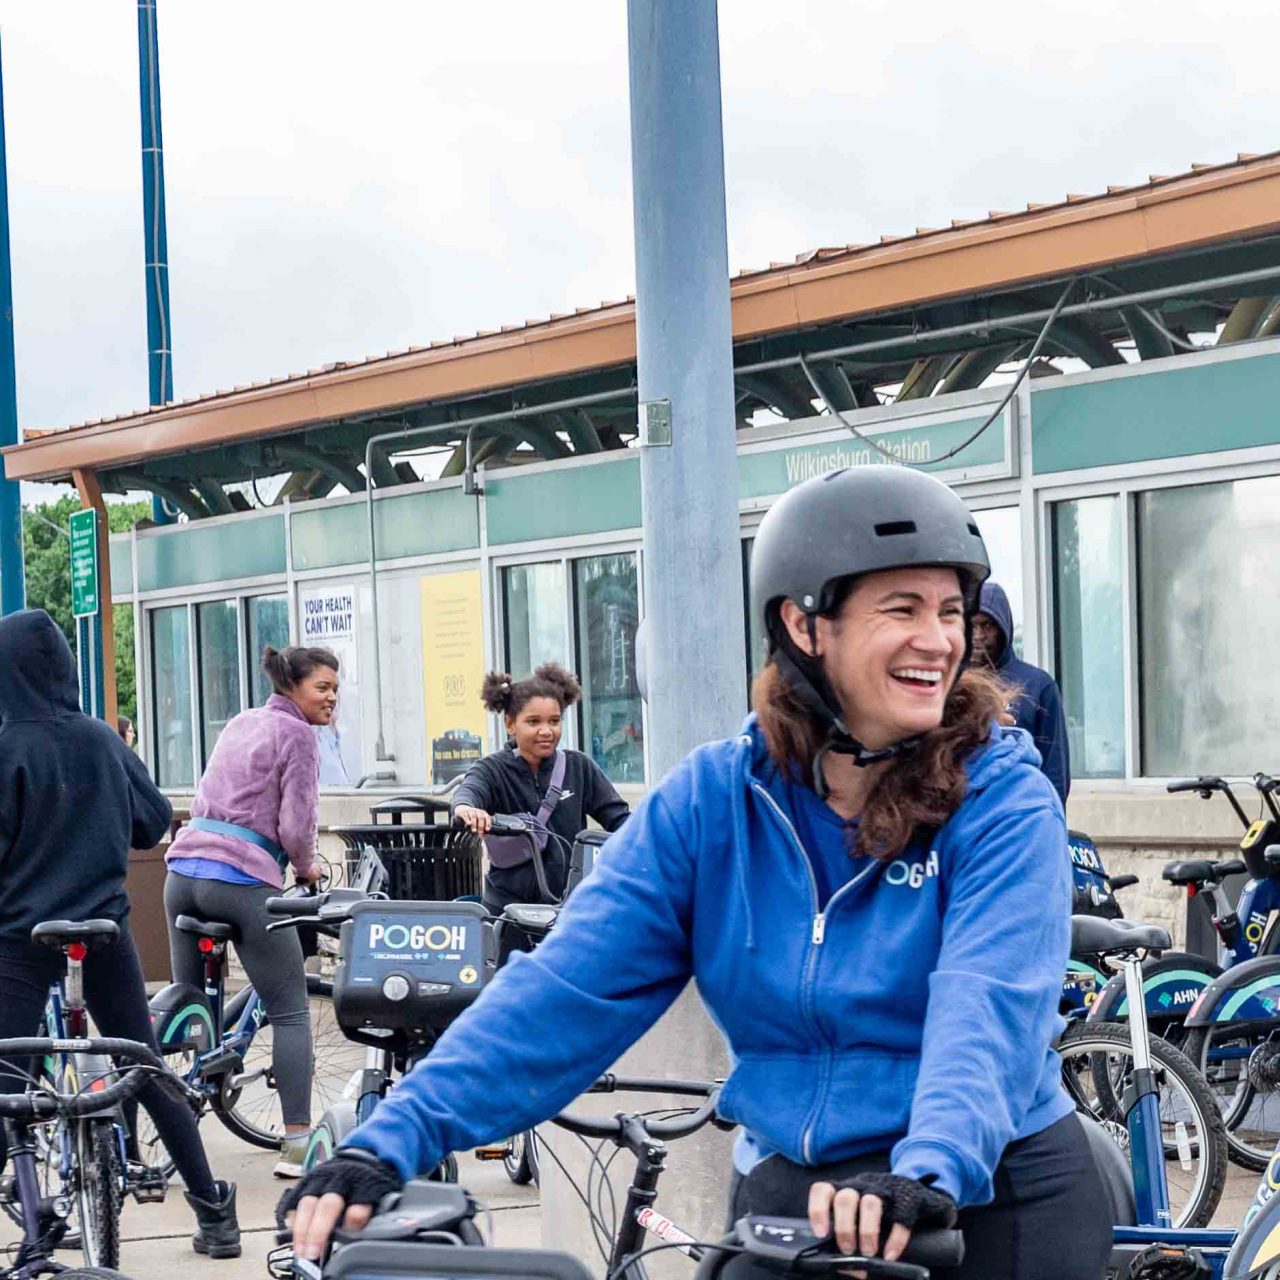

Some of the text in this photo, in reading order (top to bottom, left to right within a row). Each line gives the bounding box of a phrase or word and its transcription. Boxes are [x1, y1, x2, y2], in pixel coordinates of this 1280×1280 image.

[784, 436, 931, 482] Wilkinsburg Station
[305, 596, 352, 615] YOUR HEALTH
[305, 614, 352, 635] CAN'T WAIT
[886, 850, 939, 889] OGH
[369, 923, 467, 951] POGOH
[1173, 988, 1199, 1006] AHN
